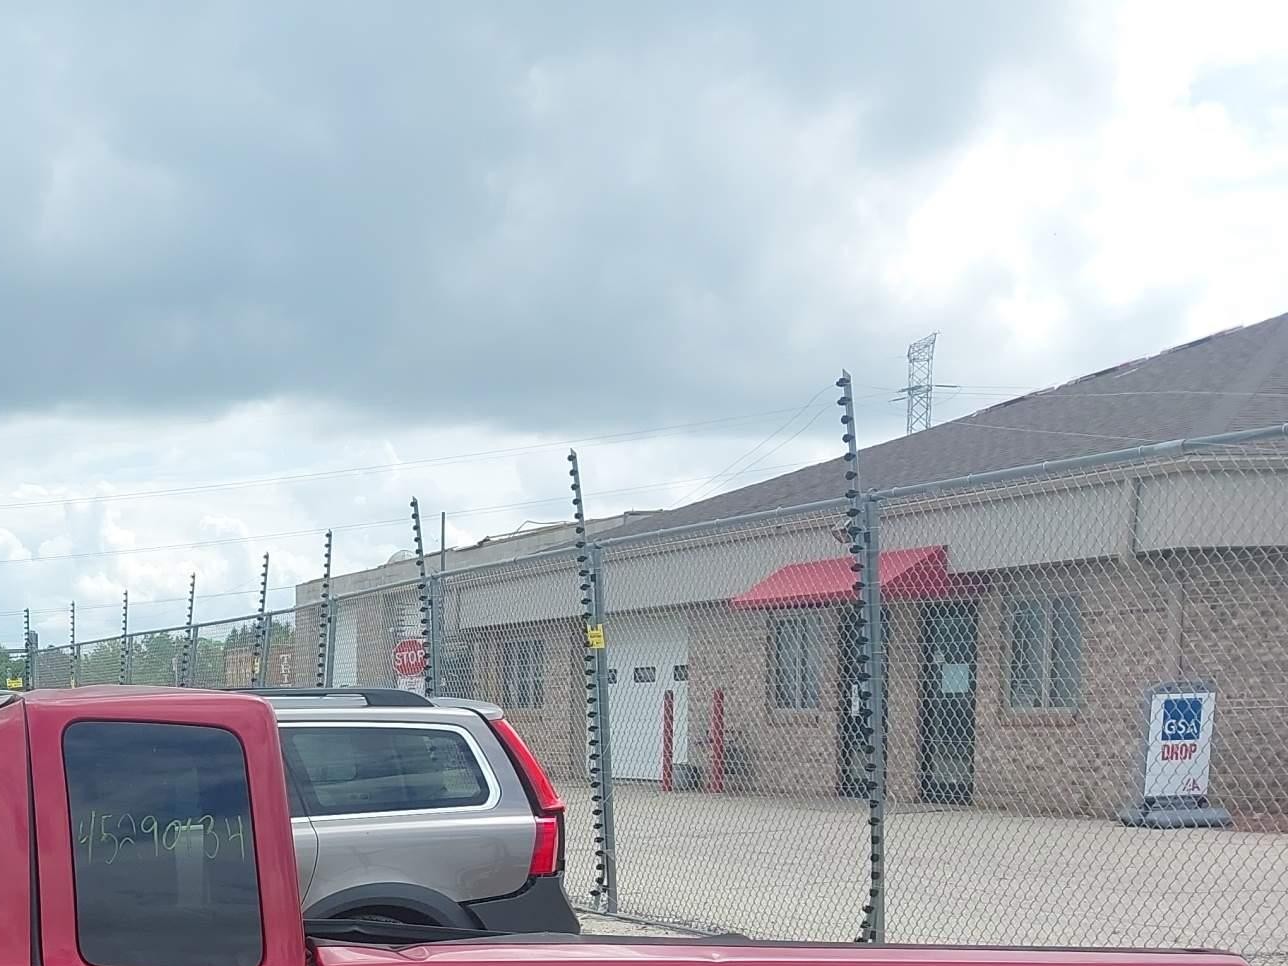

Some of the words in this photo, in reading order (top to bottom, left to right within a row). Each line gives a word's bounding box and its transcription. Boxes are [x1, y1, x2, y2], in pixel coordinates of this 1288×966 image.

[395, 650, 426, 666] STOP
[1164, 718, 1199, 735] GSA
[1161, 743, 1198, 761] DROP
